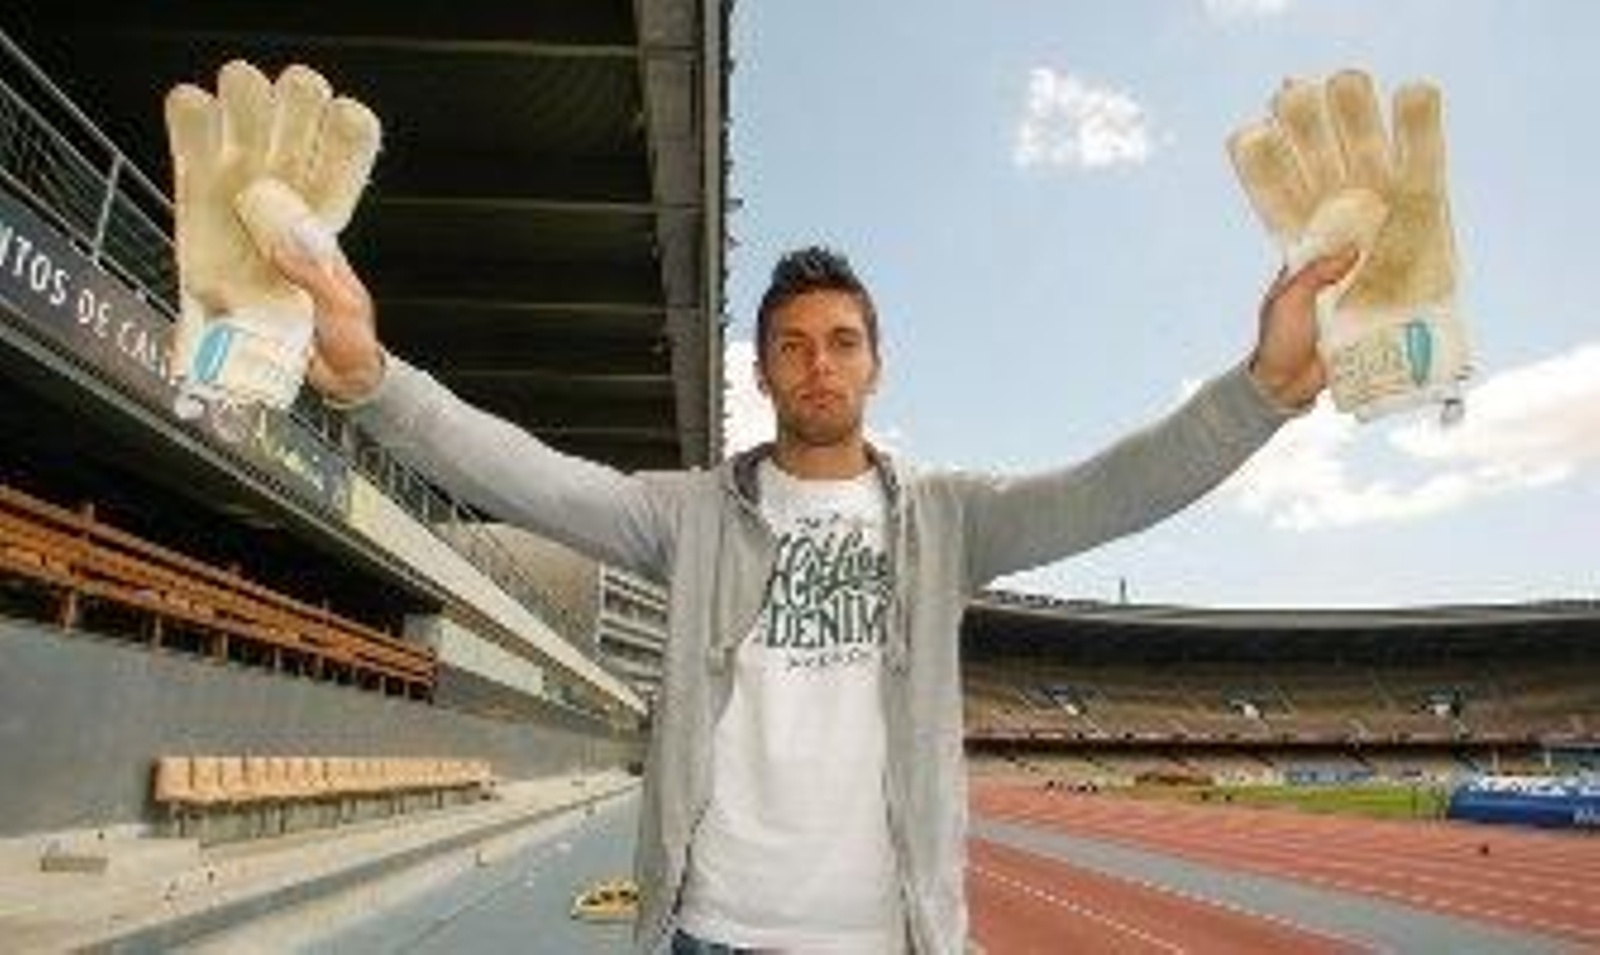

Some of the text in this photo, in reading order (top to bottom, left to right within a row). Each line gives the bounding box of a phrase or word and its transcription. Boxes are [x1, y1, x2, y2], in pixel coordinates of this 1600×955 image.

[78, 288, 112, 338] DE
[116, 320, 171, 381] CALI
[766, 595, 889, 648] DENIM
